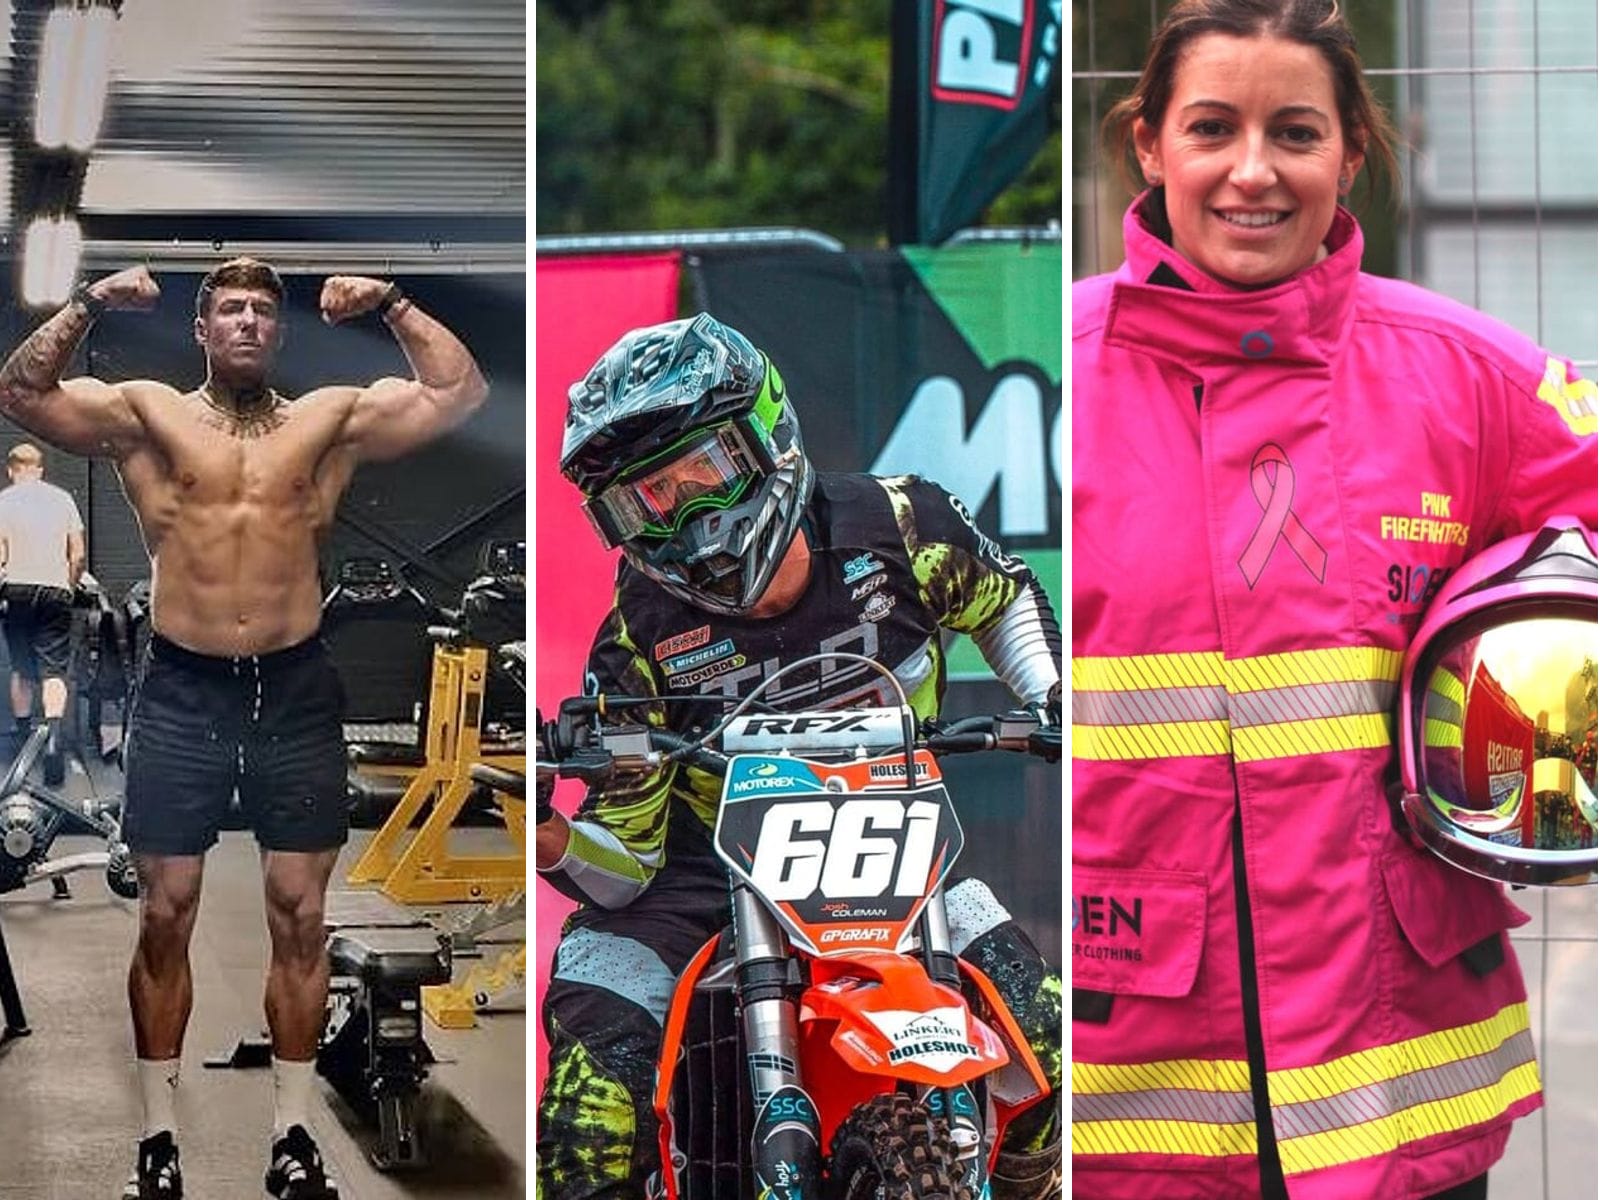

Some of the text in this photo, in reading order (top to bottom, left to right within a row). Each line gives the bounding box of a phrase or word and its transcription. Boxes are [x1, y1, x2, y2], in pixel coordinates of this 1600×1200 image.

[939, 0, 1023, 98] P
[868, 374, 1062, 536] M
[844, 552, 873, 577] SSC
[676, 643, 728, 667] MICHELIN
[670, 659, 736, 686] MOTOVERDE
[743, 714, 876, 736] RFX
[870, 762, 927, 777] HOLESOT
[734, 776, 796, 793] MOTOREX
[750, 799, 941, 901] 661
[821, 903, 851, 912] Josh
[831, 908, 888, 918] COLEMAN
[1084, 944, 1142, 962] CLOTHING
[893, 1025, 962, 1041] LINKERT
[888, 1040, 978, 1061] HOLESHOT
[770, 1098, 807, 1116] SSC
[930, 1092, 967, 1111] SC
